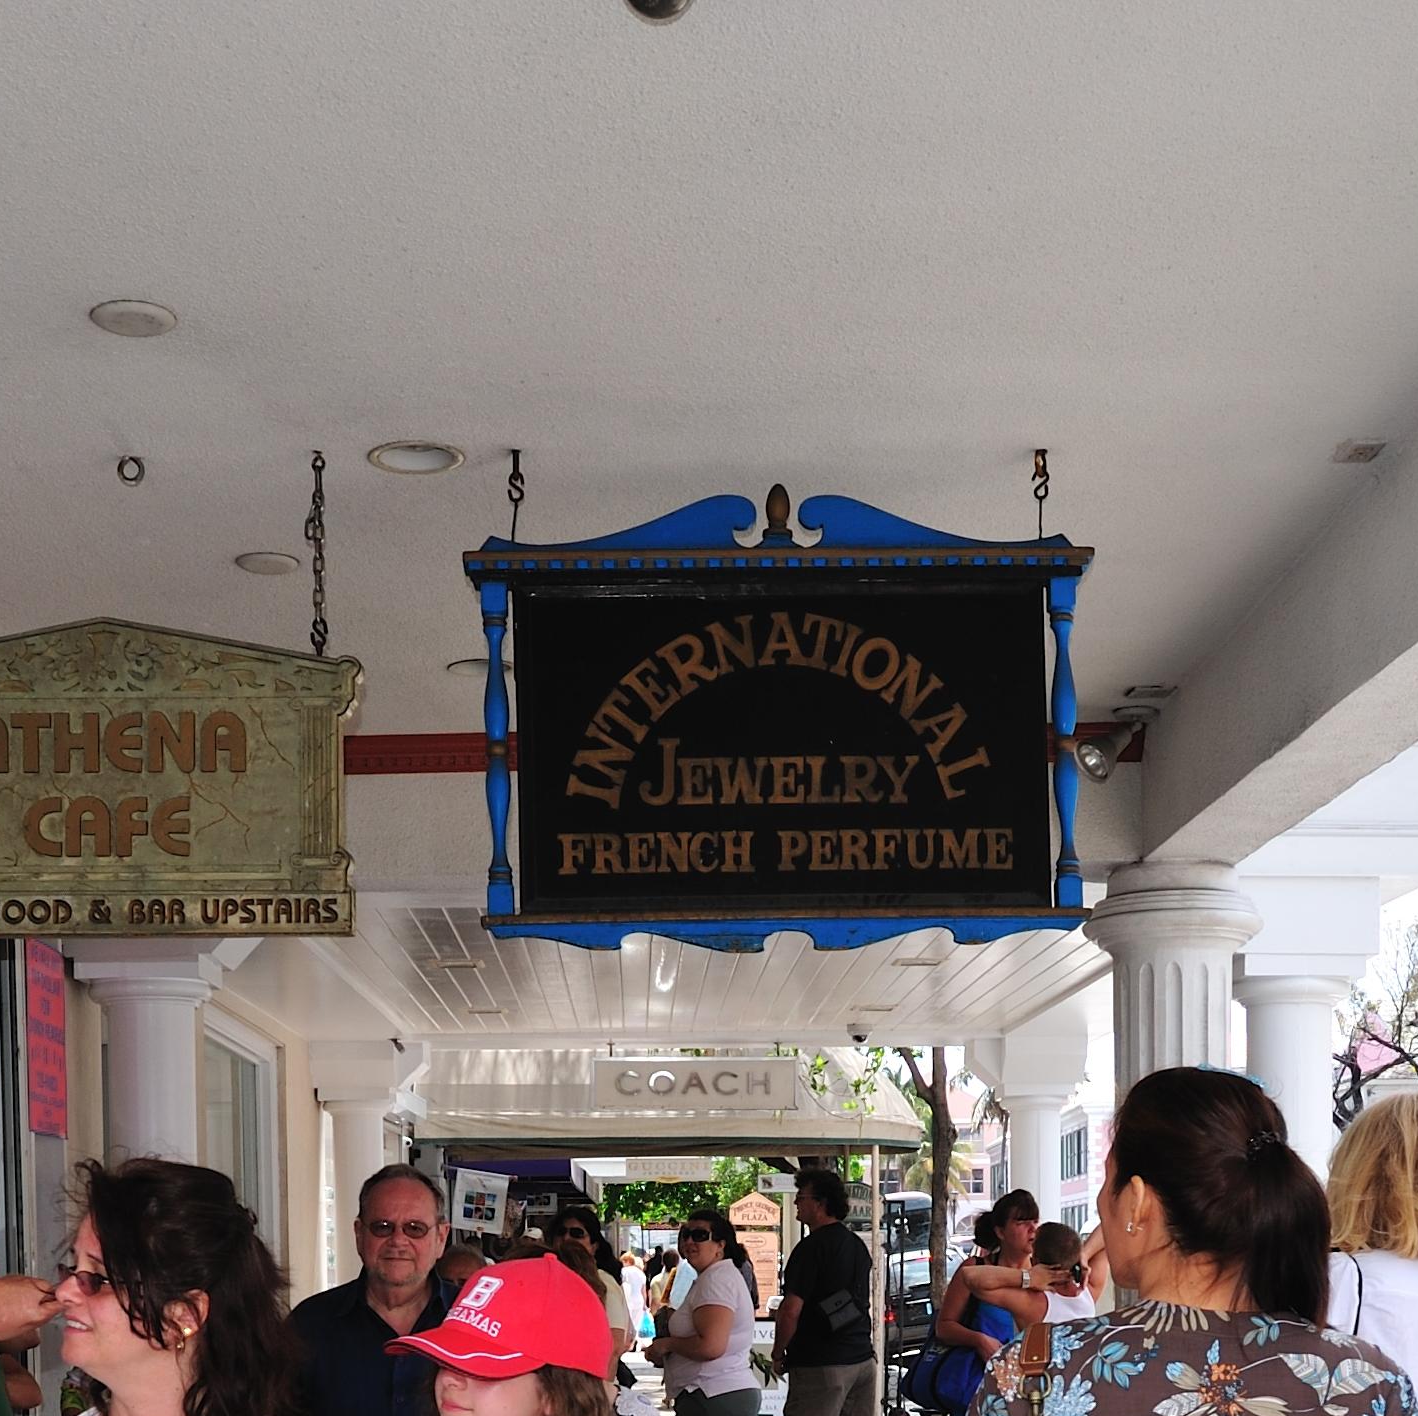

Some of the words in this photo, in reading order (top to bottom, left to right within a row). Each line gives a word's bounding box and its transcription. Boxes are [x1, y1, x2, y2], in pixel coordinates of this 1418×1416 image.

[567, 611, 990, 809] INTERNATIONAL
[639, 737, 919, 806] JEWELRY
[22, 796, 191, 858] CAFE
[557, 829, 755, 876] FRENCH
[778, 828, 1014, 871] PERFUME
[89, 899, 112, 925] &
[128, 898, 186, 925] BAR
[200, 897, 339, 925] UPSTAIRS
[615, 1070, 771, 1096] COACH
[460, 1276, 504, 1309] B
